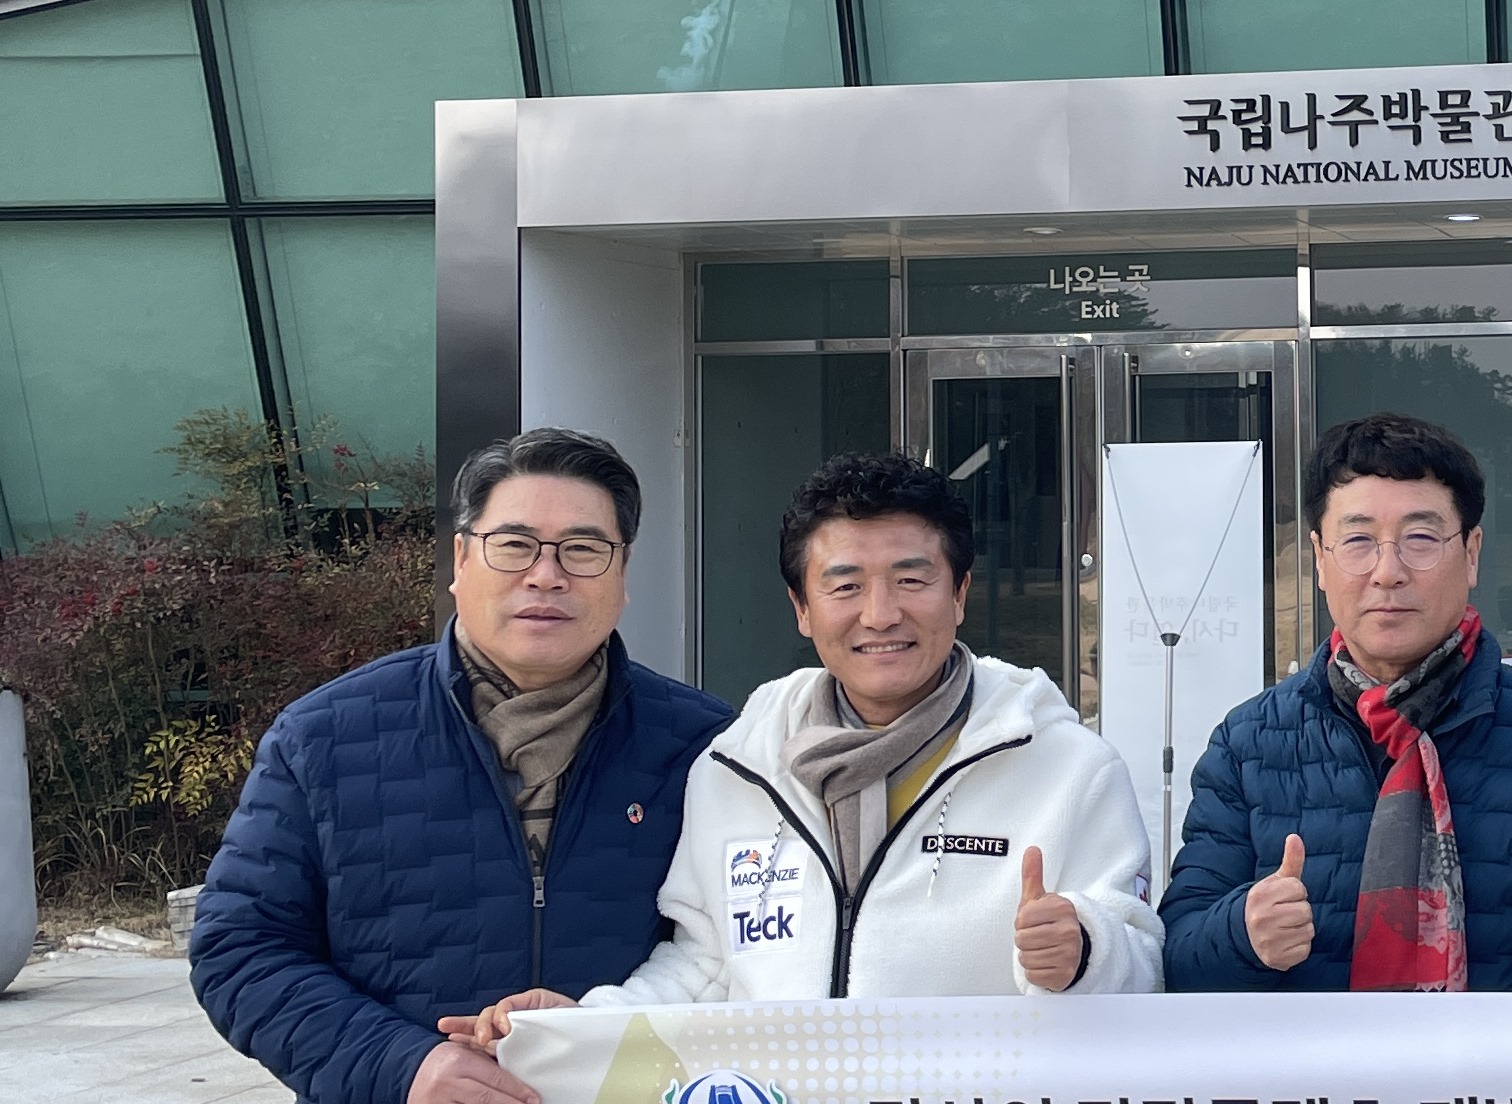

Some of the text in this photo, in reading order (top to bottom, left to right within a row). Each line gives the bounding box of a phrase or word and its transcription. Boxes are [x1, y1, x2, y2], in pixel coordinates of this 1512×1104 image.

[1184, 164, 1254, 187] NAJU
[1261, 159, 1399, 185] NATIONAL
[1049, 264, 1151, 294] 나오는 곳
[1081, 299, 1119, 318] Exit
[927, 838, 1003, 852] DSCENTE
[733, 905, 794, 944] Teck
